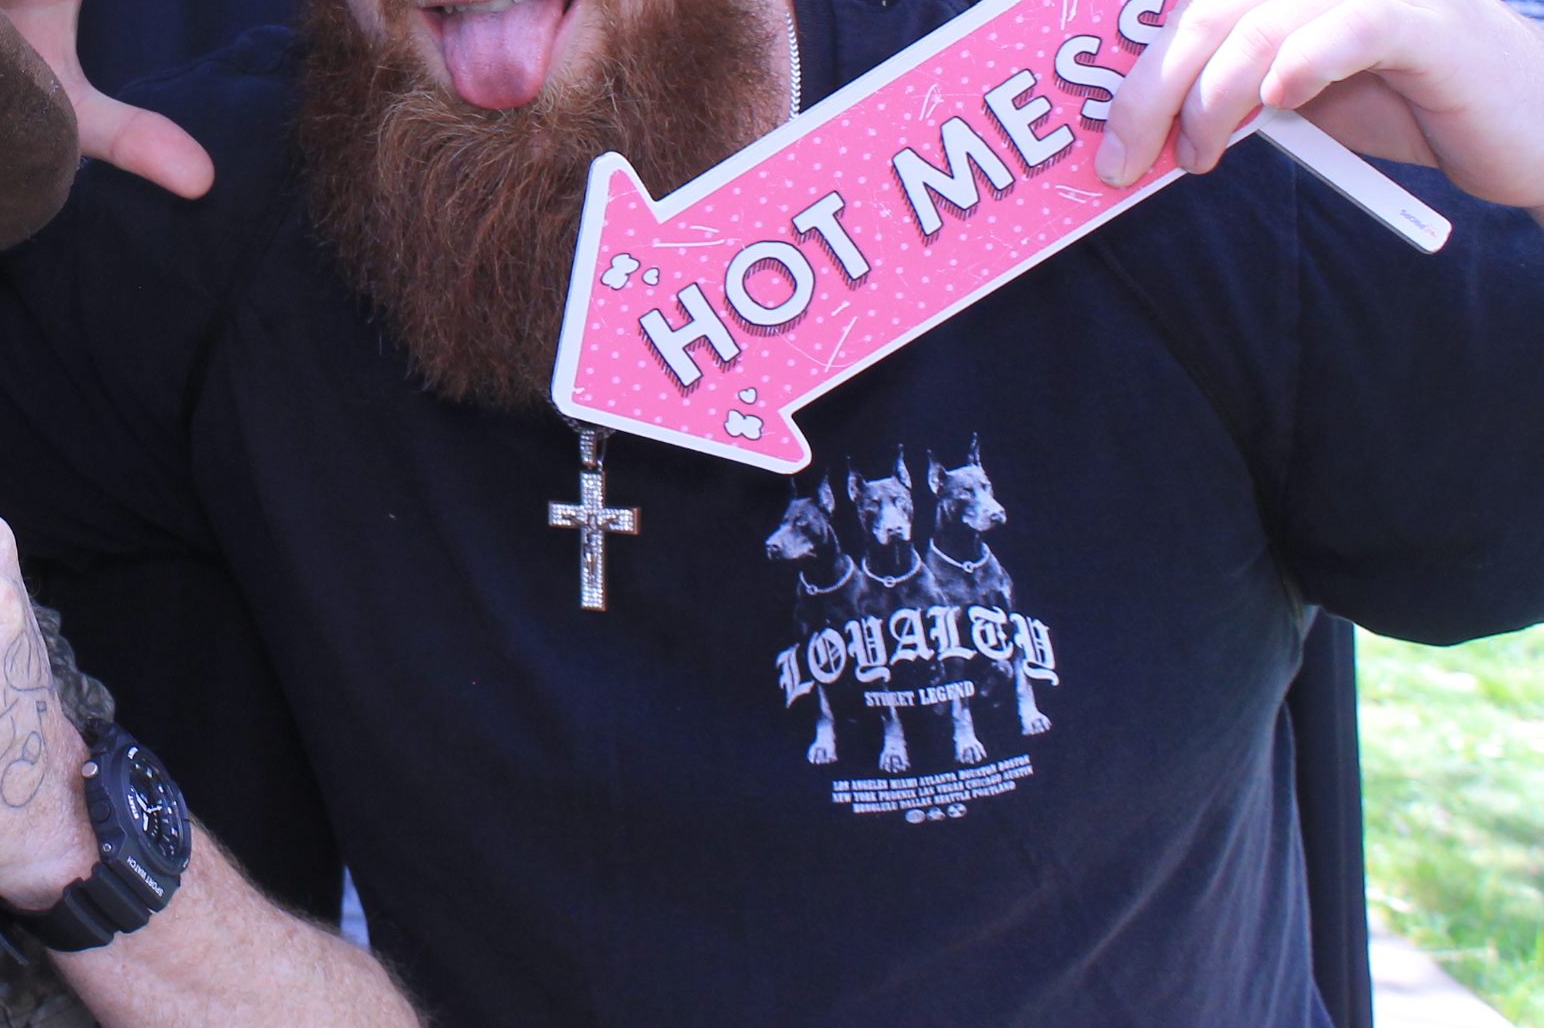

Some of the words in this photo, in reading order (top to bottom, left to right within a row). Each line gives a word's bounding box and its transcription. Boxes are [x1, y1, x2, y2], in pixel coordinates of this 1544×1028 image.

[637, 189, 872, 392] HOT
[775, 604, 1060, 709] LOYALTY
[863, 690, 915, 707] STREET
[918, 680, 976, 706] LEGEND
[126, 856, 146, 880] WATCH
[144, 874, 164, 897] SPORT
